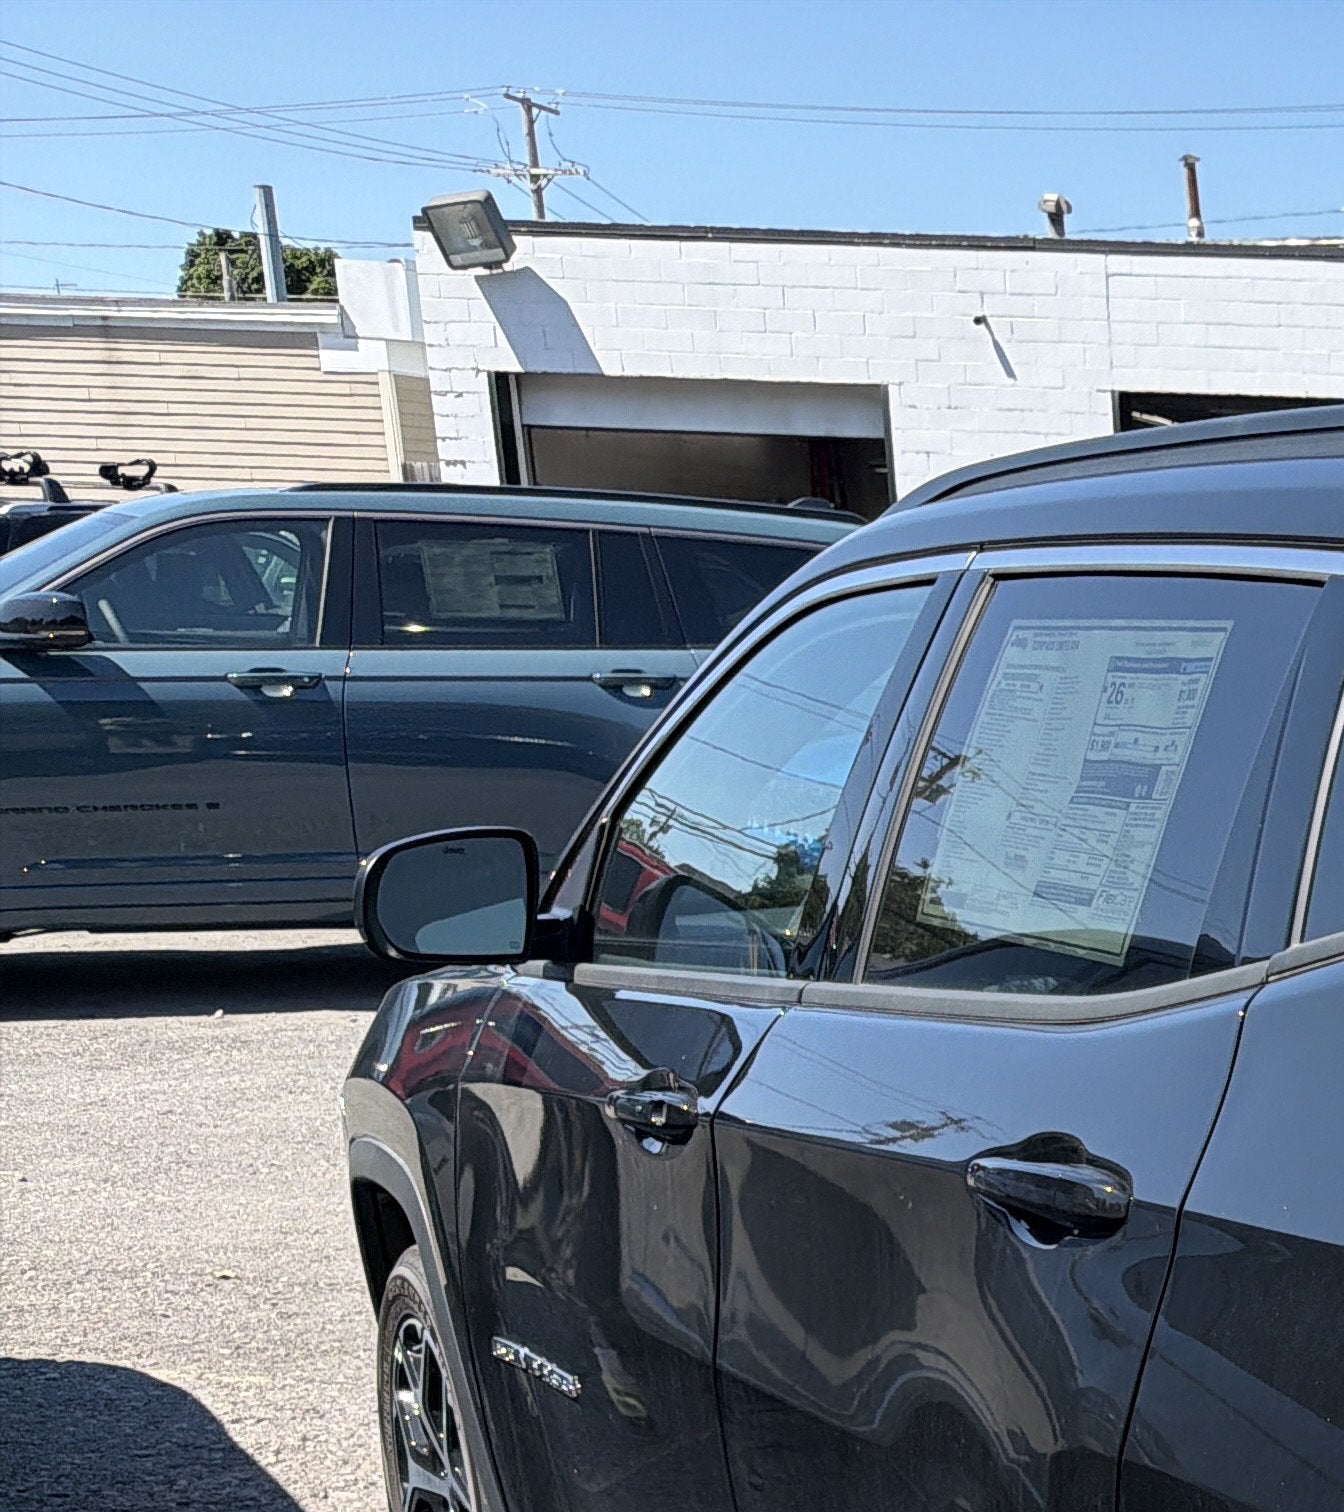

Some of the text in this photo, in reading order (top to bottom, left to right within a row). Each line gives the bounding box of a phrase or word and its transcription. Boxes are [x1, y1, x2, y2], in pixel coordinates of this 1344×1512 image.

[1107, 680, 1126, 705] 26
[0, 805, 70, 815] RAND
[75, 802, 200, 813] CHEROKEE
